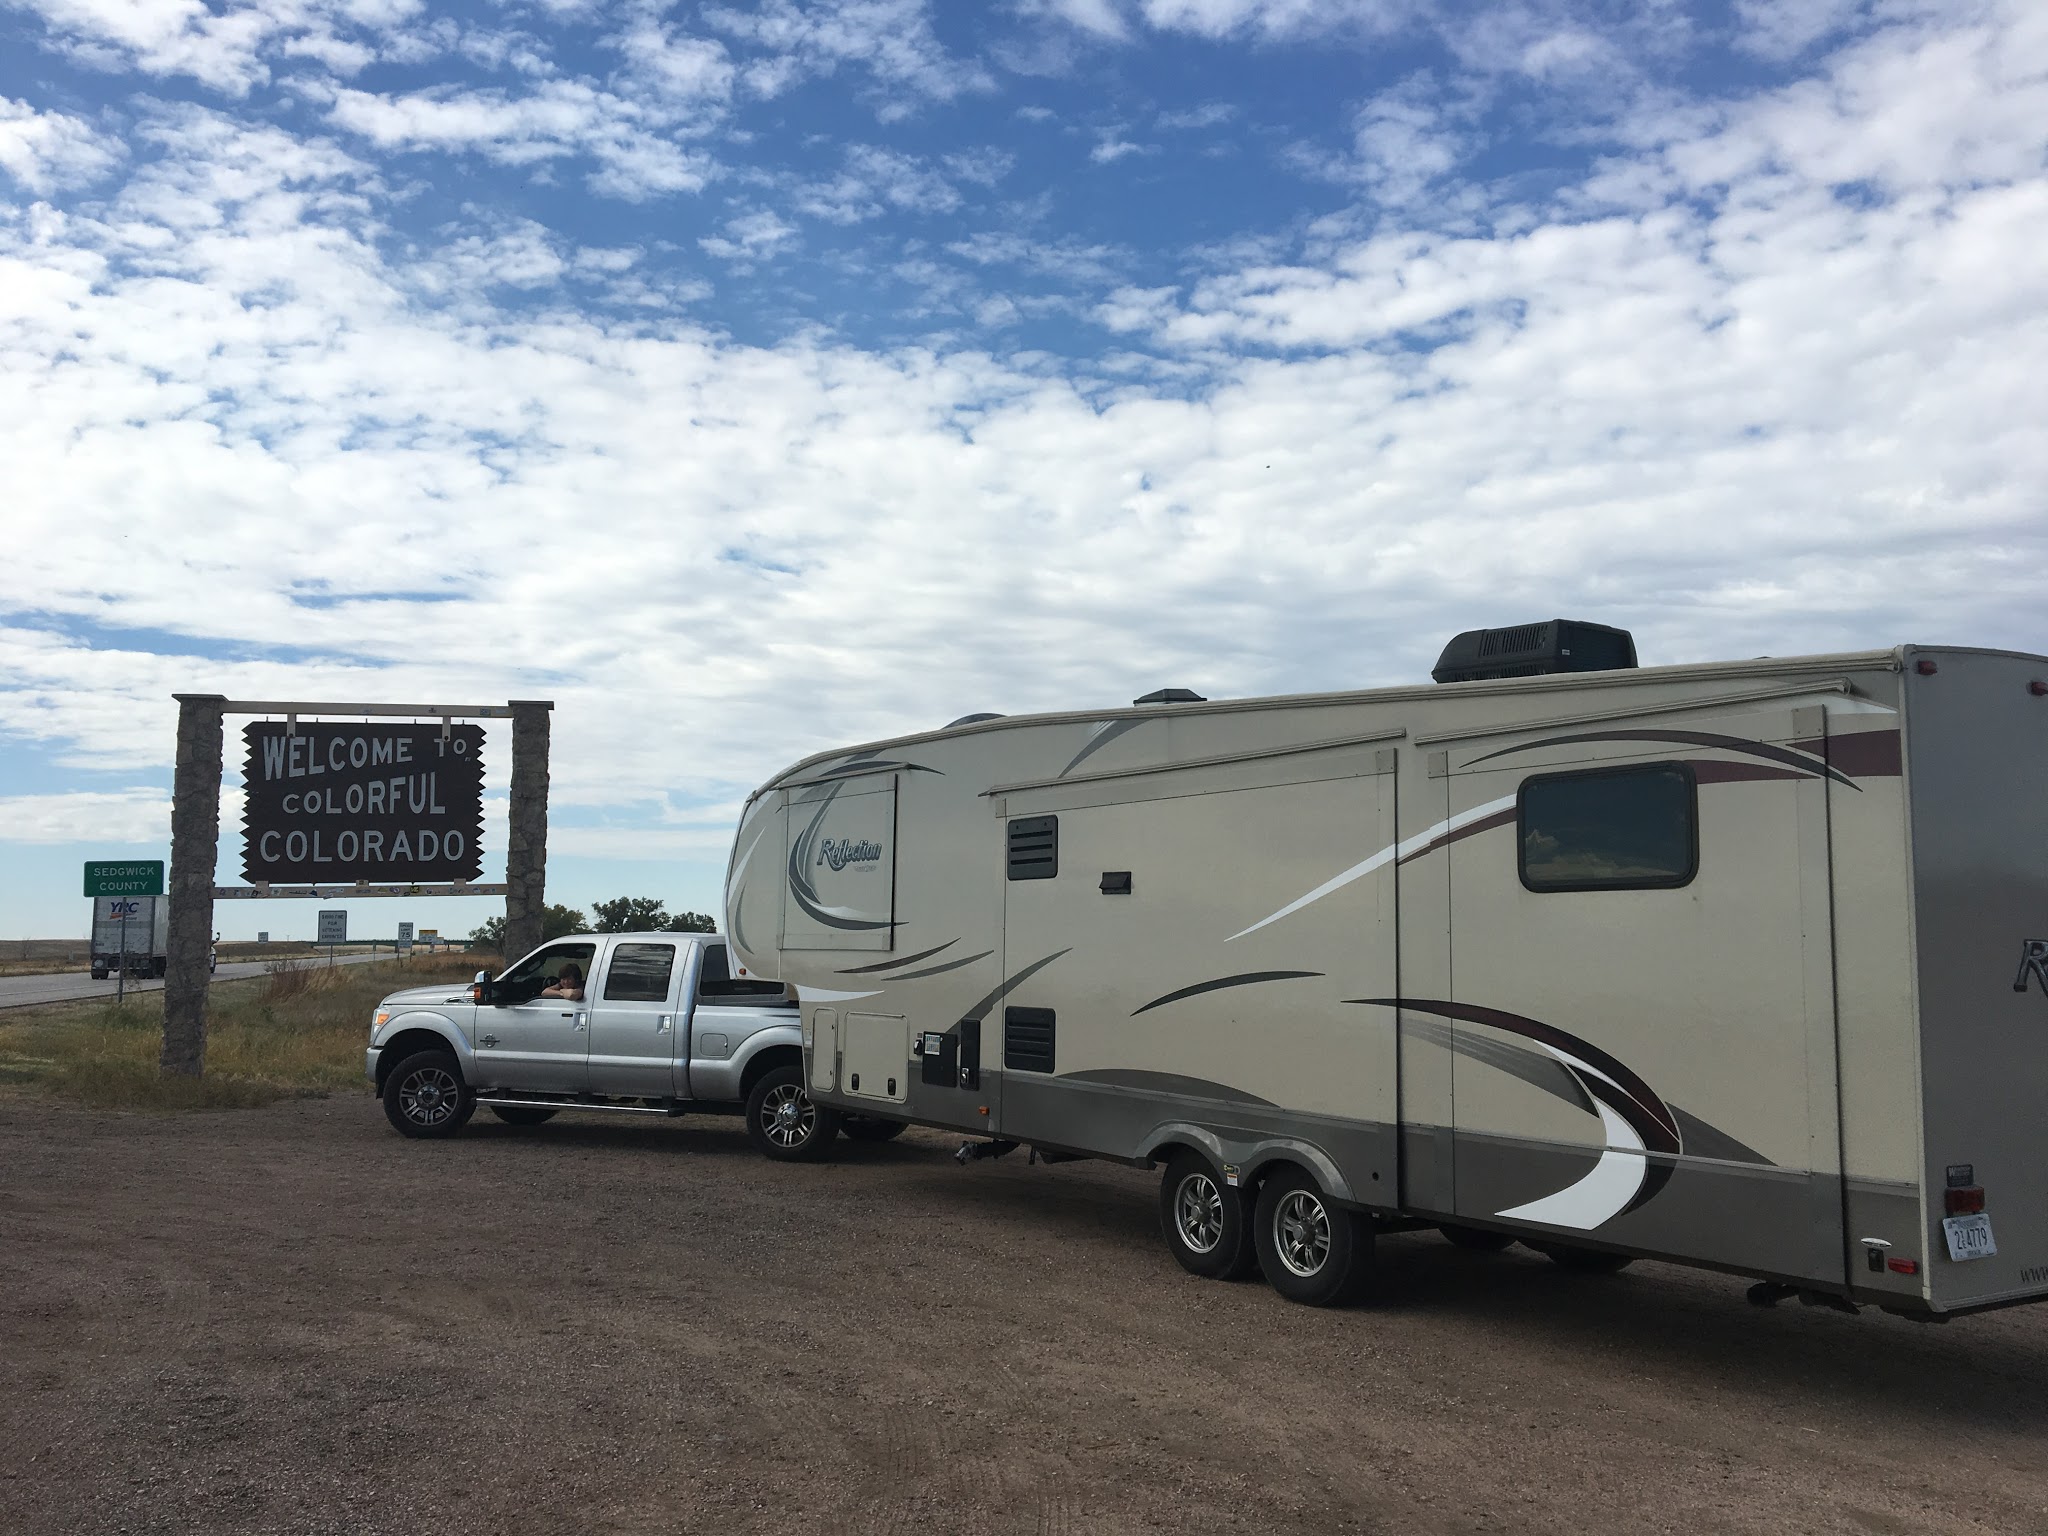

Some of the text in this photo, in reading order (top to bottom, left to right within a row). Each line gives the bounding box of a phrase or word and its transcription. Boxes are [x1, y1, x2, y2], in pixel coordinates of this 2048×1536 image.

[262, 735, 467, 781] WELCOME TO
[282, 771, 446, 814] COLORFUL
[259, 829, 465, 863] COLORADO
[816, 838, 882, 871] Reflection
[93, 866, 155, 876] SEDGWICK
[99, 881, 148, 891] COUNTY
[110, 901, 140, 913] YRC
